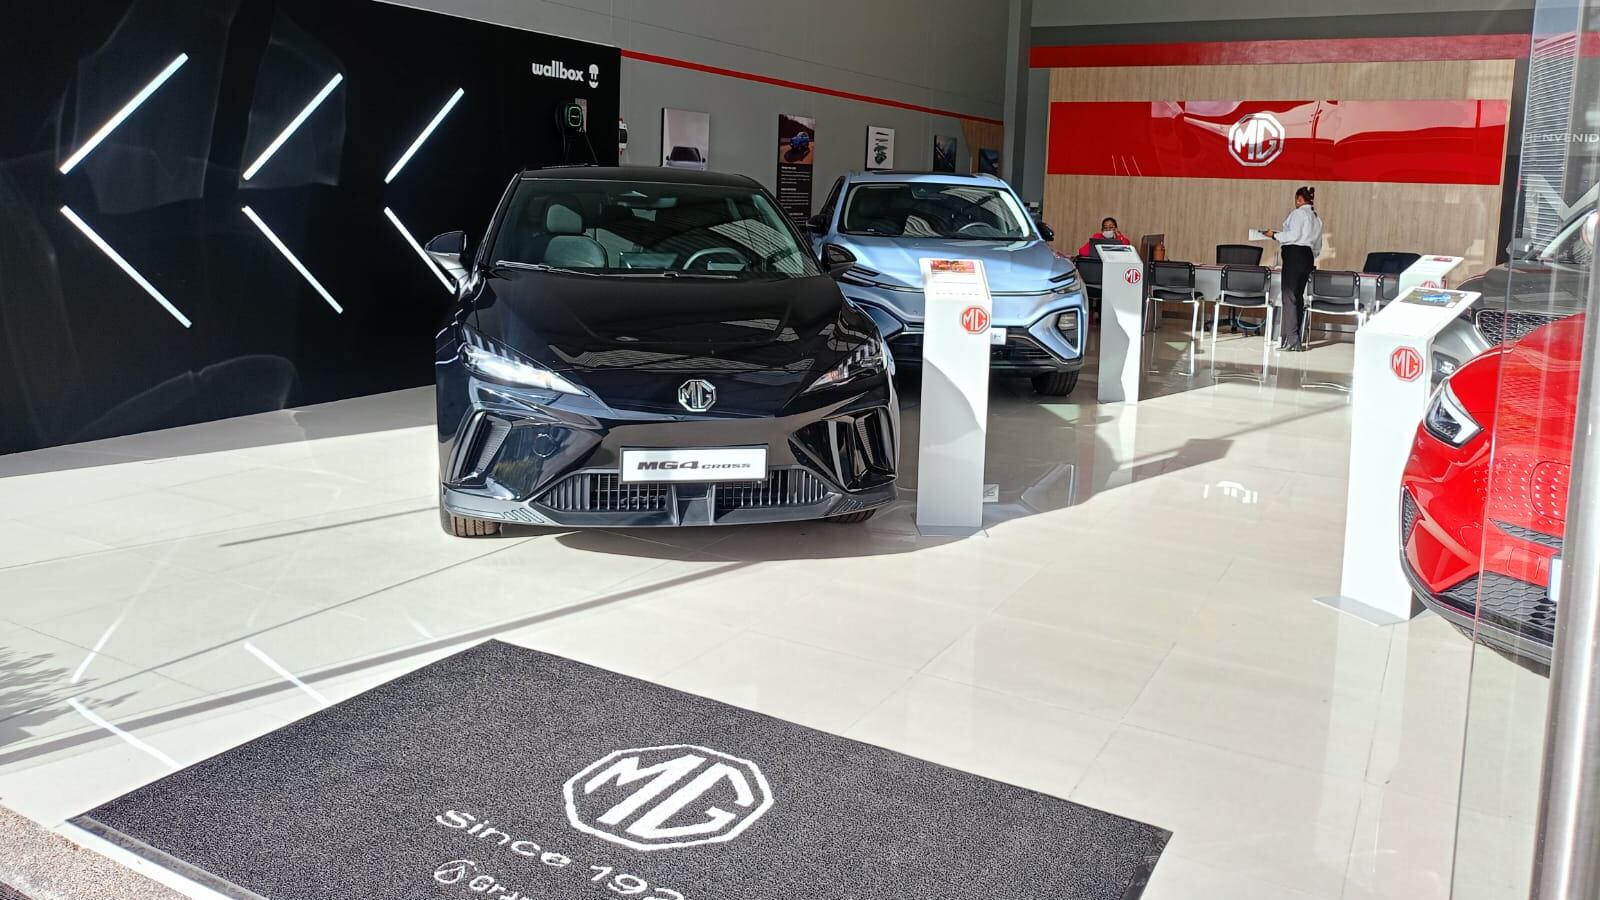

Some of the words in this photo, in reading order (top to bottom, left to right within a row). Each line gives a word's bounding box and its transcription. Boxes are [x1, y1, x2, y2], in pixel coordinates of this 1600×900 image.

[532, 60, 584, 82] wallbox
[1232, 116, 1280, 161] MG
[1125, 268, 1141, 284] MG
[962, 306, 989, 333] MG
[1392, 348, 1421, 380] MG
[680, 380, 715, 410] MG
[637, 460, 699, 471] MG4
[582, 752, 756, 840] MG
[435, 810, 571, 867] Since
